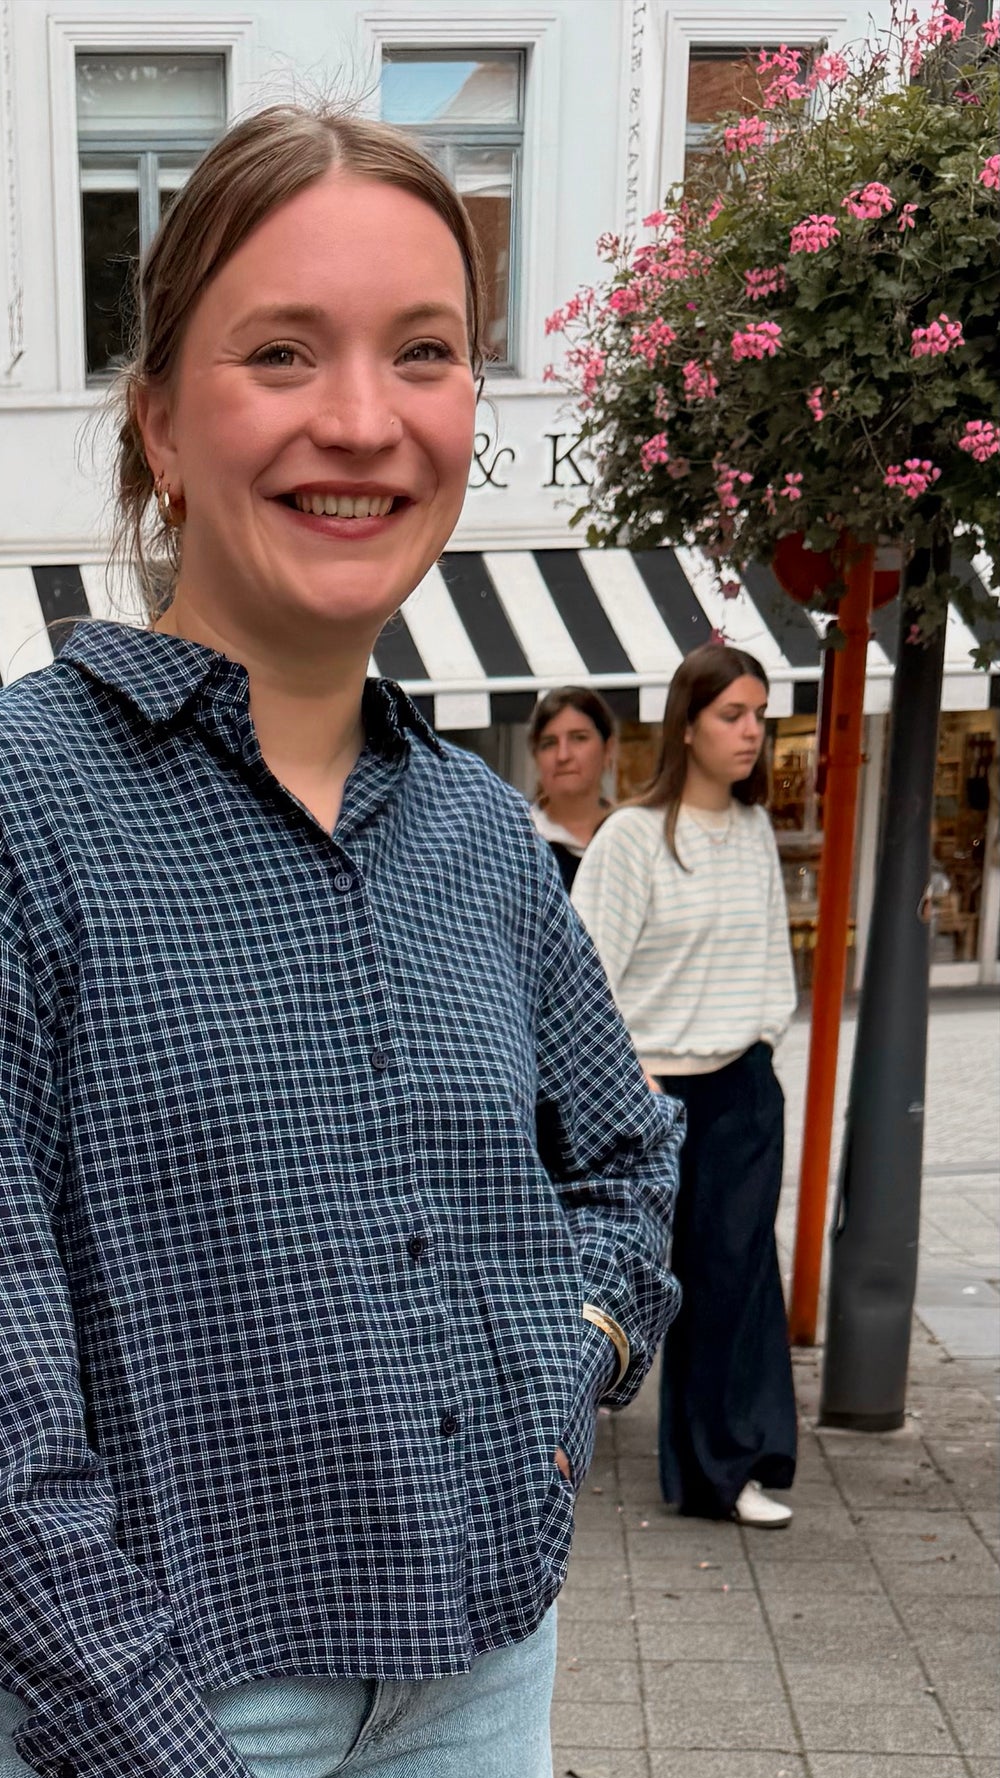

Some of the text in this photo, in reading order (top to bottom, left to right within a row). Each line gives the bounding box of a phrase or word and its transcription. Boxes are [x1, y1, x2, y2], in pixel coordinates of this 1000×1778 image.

[631, 0, 647, 72] LLE
[626, 118, 640, 235] KAMIL
[469, 432, 515, 488] &
